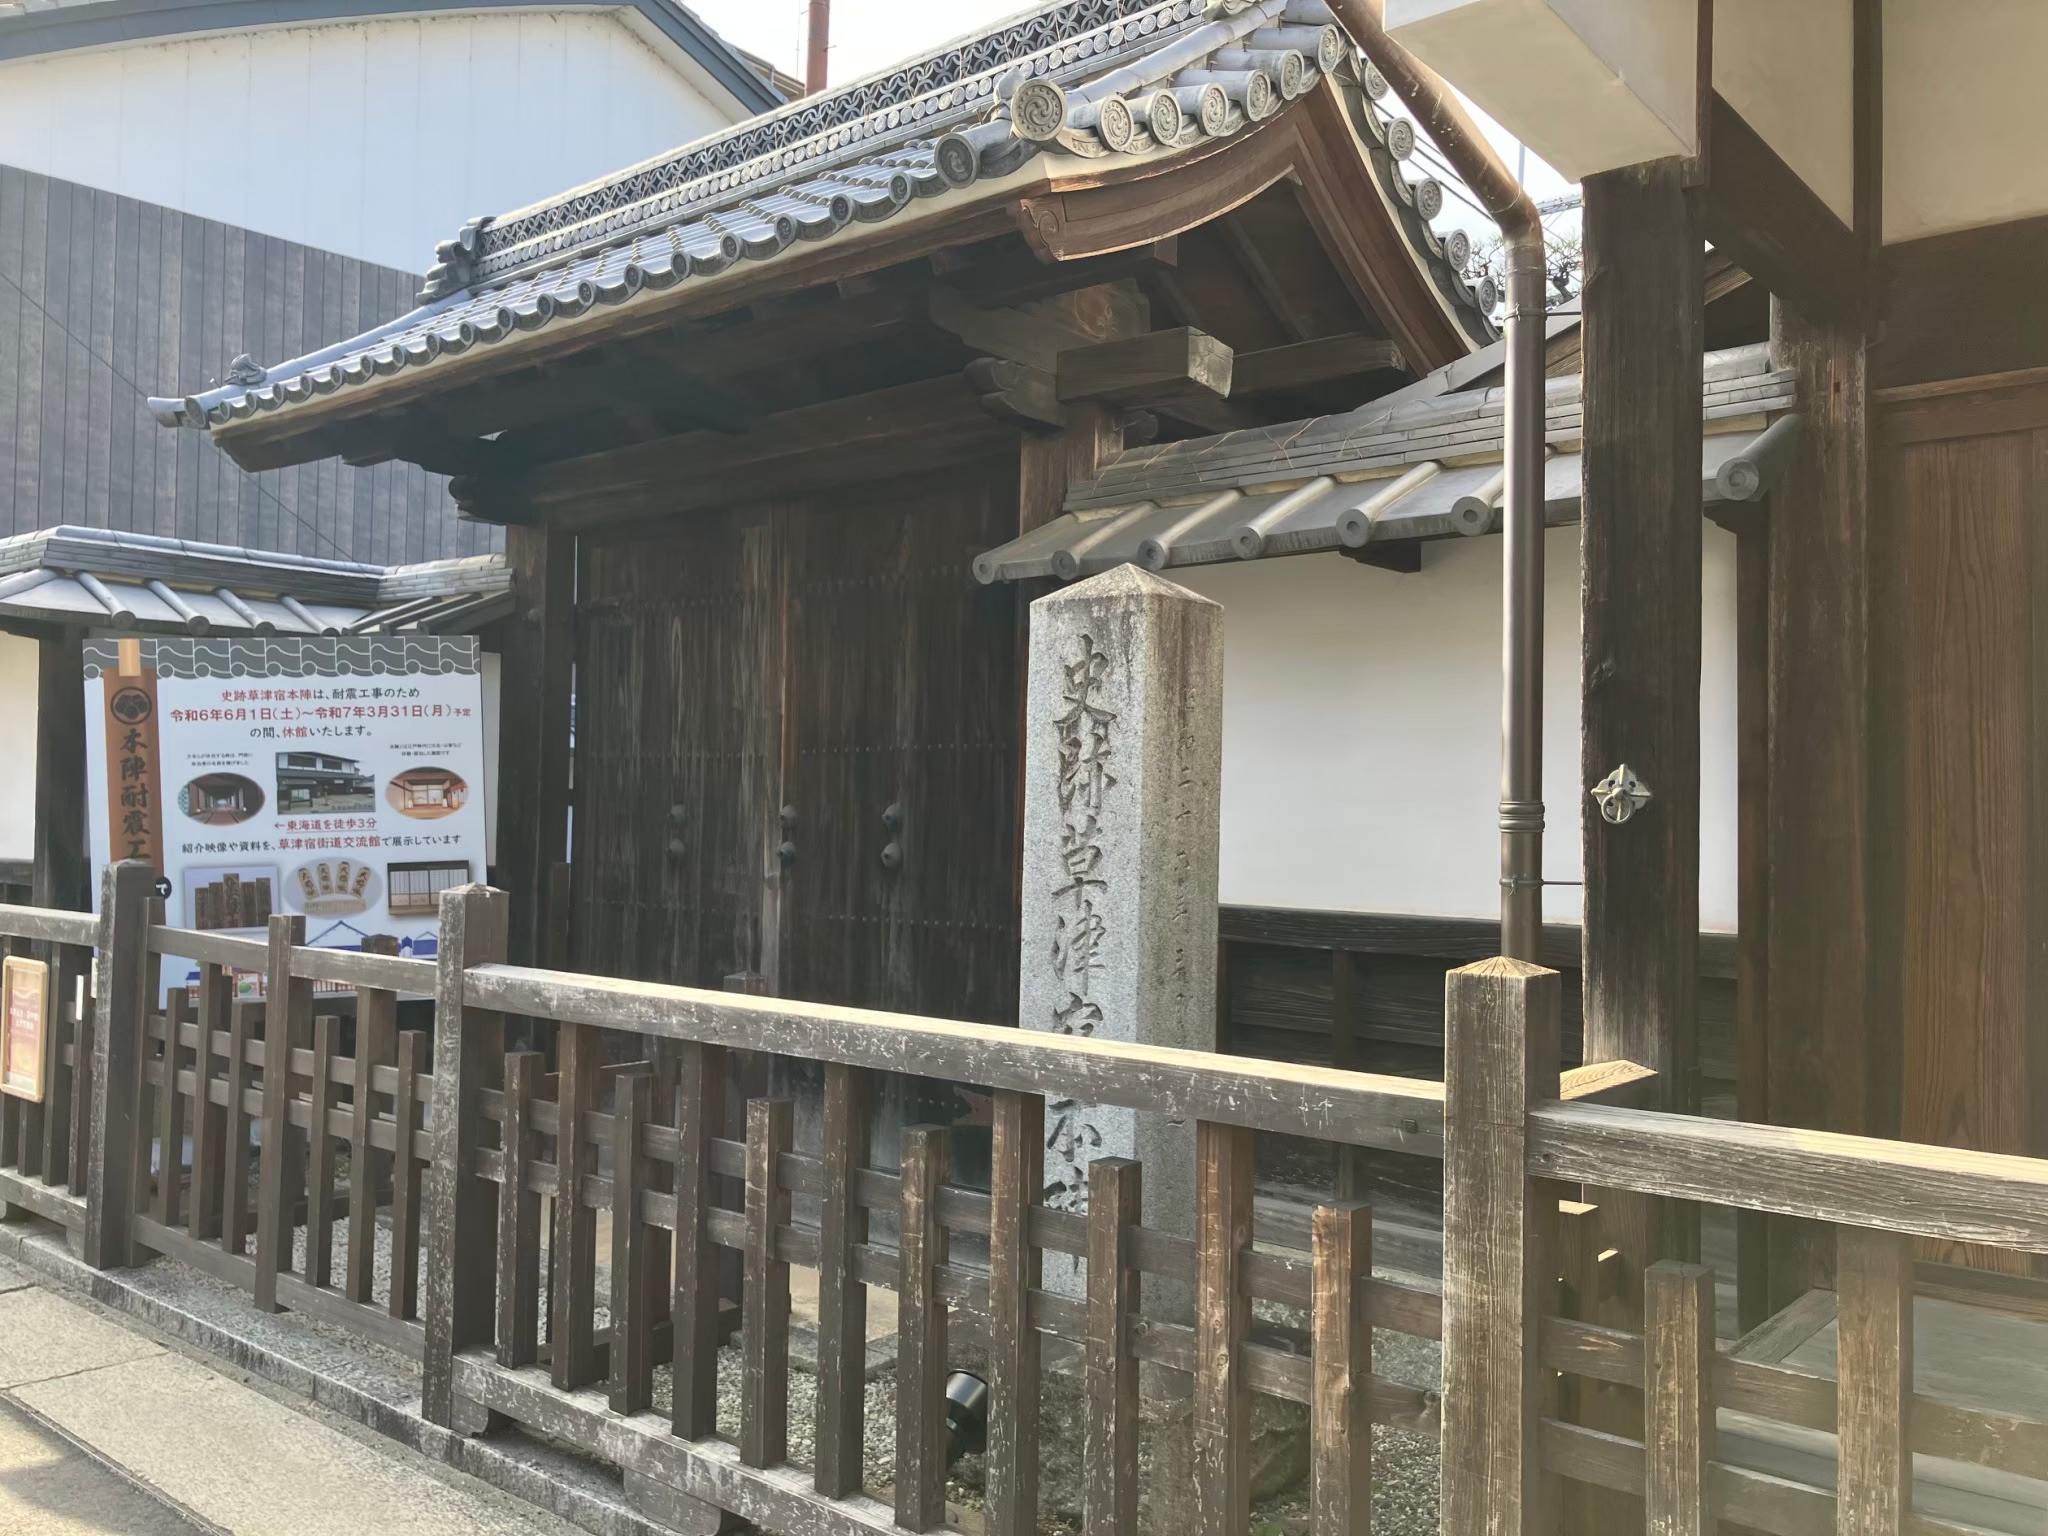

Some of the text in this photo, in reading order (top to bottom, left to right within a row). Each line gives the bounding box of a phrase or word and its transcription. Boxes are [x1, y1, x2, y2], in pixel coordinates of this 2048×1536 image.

[221, 687, 420, 702] 史跡草津宿本陣は、耐震工事のため
[250, 725, 372, 738] の間、休館いたします。
[286, 817, 377, 831] 東海道を徒歩3分
